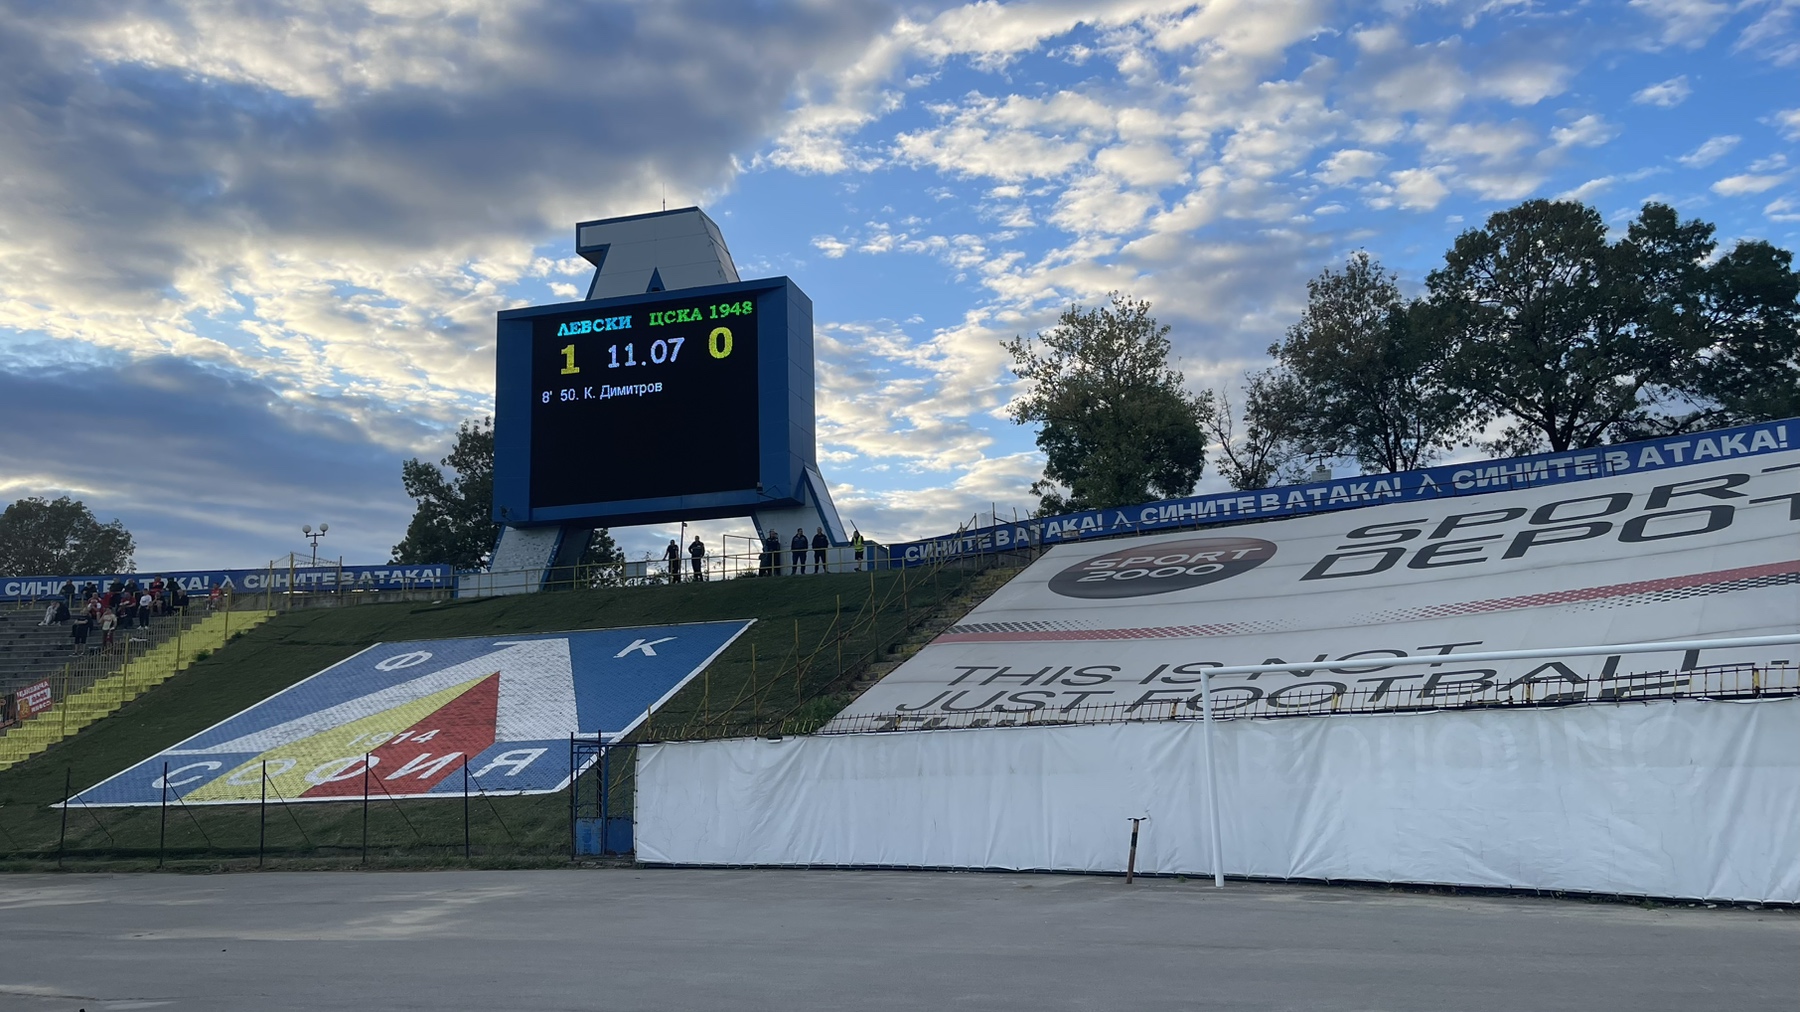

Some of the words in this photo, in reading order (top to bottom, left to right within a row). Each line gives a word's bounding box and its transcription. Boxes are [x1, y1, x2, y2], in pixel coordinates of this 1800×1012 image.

[557, 315, 633, 337] ЛЕВСКИ
[649, 308, 703, 326] ЦСКА
[709, 301, 753, 319] 1948
[561, 344, 580, 375] 1
[708, 327, 733, 359] 0
[560, 388, 579, 402] 50.
[584, 386, 596, 399] К.
[600, 382, 663, 400] Димитров
[1452, 453, 1598, 490] СИНИТЕ
[1637, 425, 1788, 468] АТАКА!
[1140, 496, 1256, 525] СИНИТЕ
[1285, 477, 1402, 510] АТАКА!
[1336, 463, 1800, 550] SPOR
[1076, 563, 1225, 583] 2000
[1083, 548, 1263, 570] SPORT
[947, 665, 1122, 686] THIS
[1138, 661, 1225, 684] IS
[1246, 640, 1484, 681] NOT
[896, 689, 1115, 713] JUST
[347, 729, 441, 748] 1914
[151, 747, 548, 788] СОФИЯ
